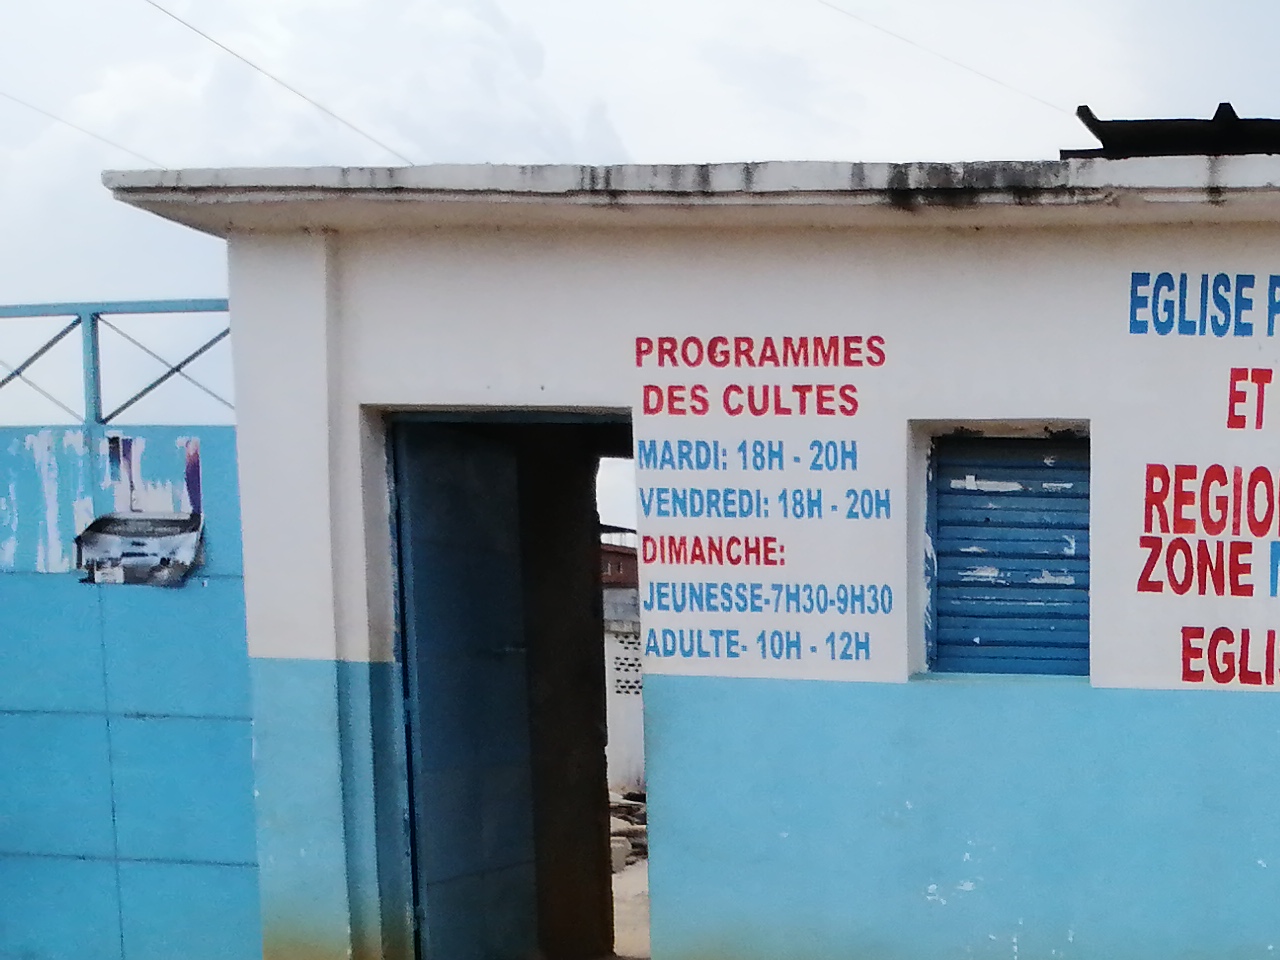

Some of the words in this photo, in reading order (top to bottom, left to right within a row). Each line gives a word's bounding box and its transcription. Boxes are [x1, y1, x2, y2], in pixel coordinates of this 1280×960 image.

[1129, 272, 1256, 337] EGLISE
[635, 335, 887, 368] PROGRAMMES
[642, 384, 710, 416] DES
[721, 384, 860, 417] CULTES
[1226, 367, 1274, 431] ET
[637, 440, 728, 472] MARDI:
[736, 440, 785, 471] 18H
[808, 440, 859, 471] 20H
[638, 487, 770, 519] VENDREDI:
[777, 487, 823, 519] 18H
[844, 488, 892, 520] 20H
[641, 535, 786, 566] DIMANCHE:
[1137, 536, 1254, 597] ZONE
[755, 630, 802, 660] 10H
[824, 631, 871, 660] 12H
